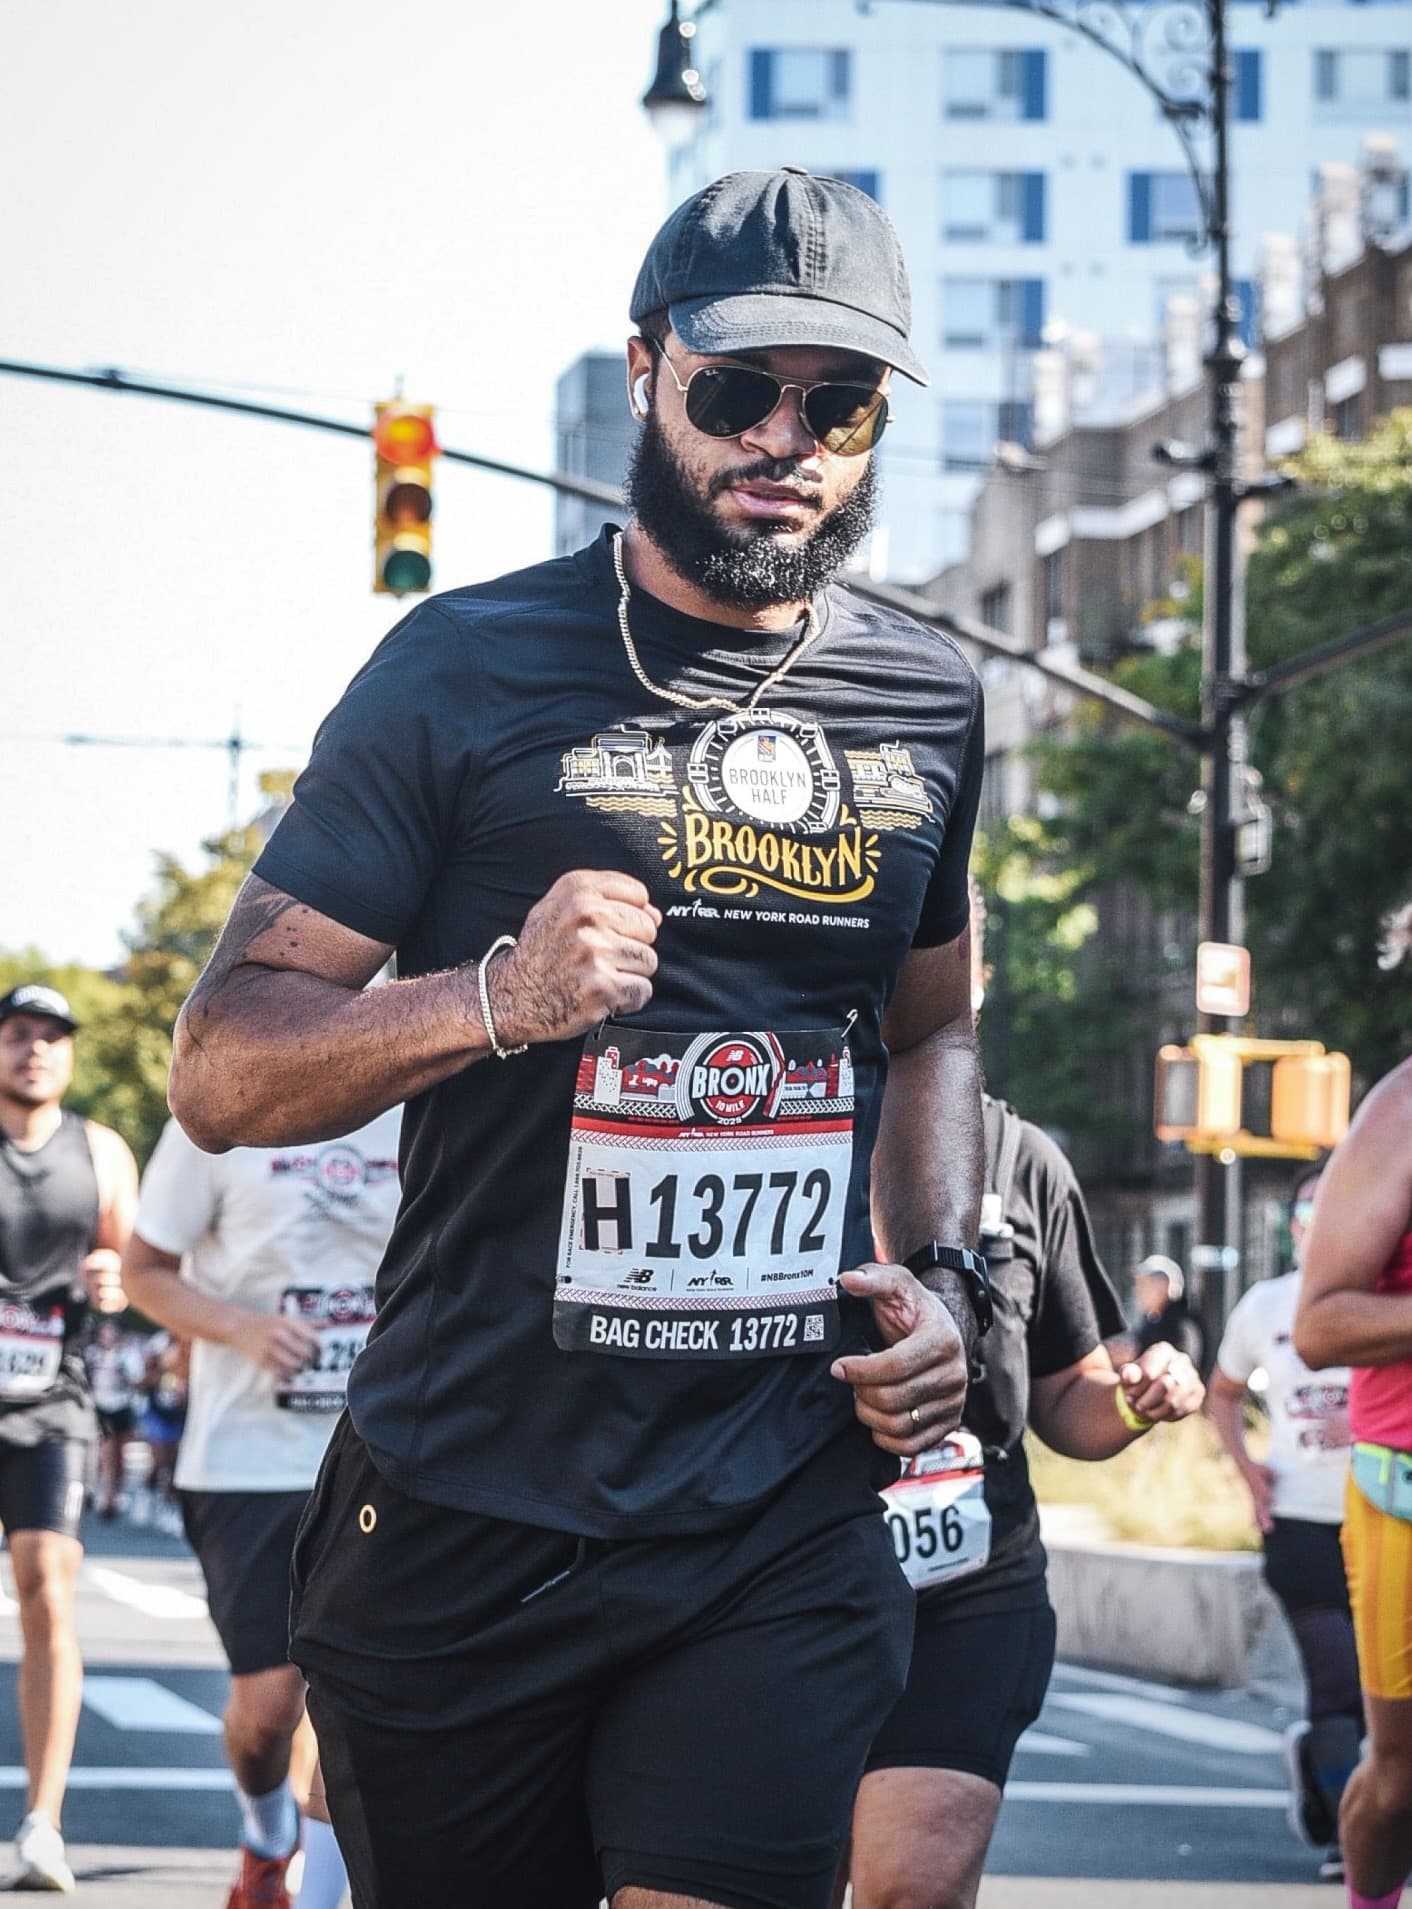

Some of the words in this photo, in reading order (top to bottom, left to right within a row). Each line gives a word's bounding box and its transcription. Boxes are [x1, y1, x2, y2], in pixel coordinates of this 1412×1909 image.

[729, 768, 806, 788] BROOKLYN
[751, 788, 788, 805] HALF
[684, 812, 862, 887] BROOKLYN
[723, 909, 752, 920] NEW
[755, 910, 787, 923] YORK
[789, 913, 820, 925] ROAD
[822, 915, 870, 929] RUNNERS
[691, 1063, 770, 1099] BRONX
[725, 1099, 745, 1113] MILE
[760, 1269, 814, 1283] #NBBronx10M
[590, 1315, 640, 1348] BAG
[645, 1320, 720, 1350] CHECK
[729, 1313, 798, 1351] 13772
